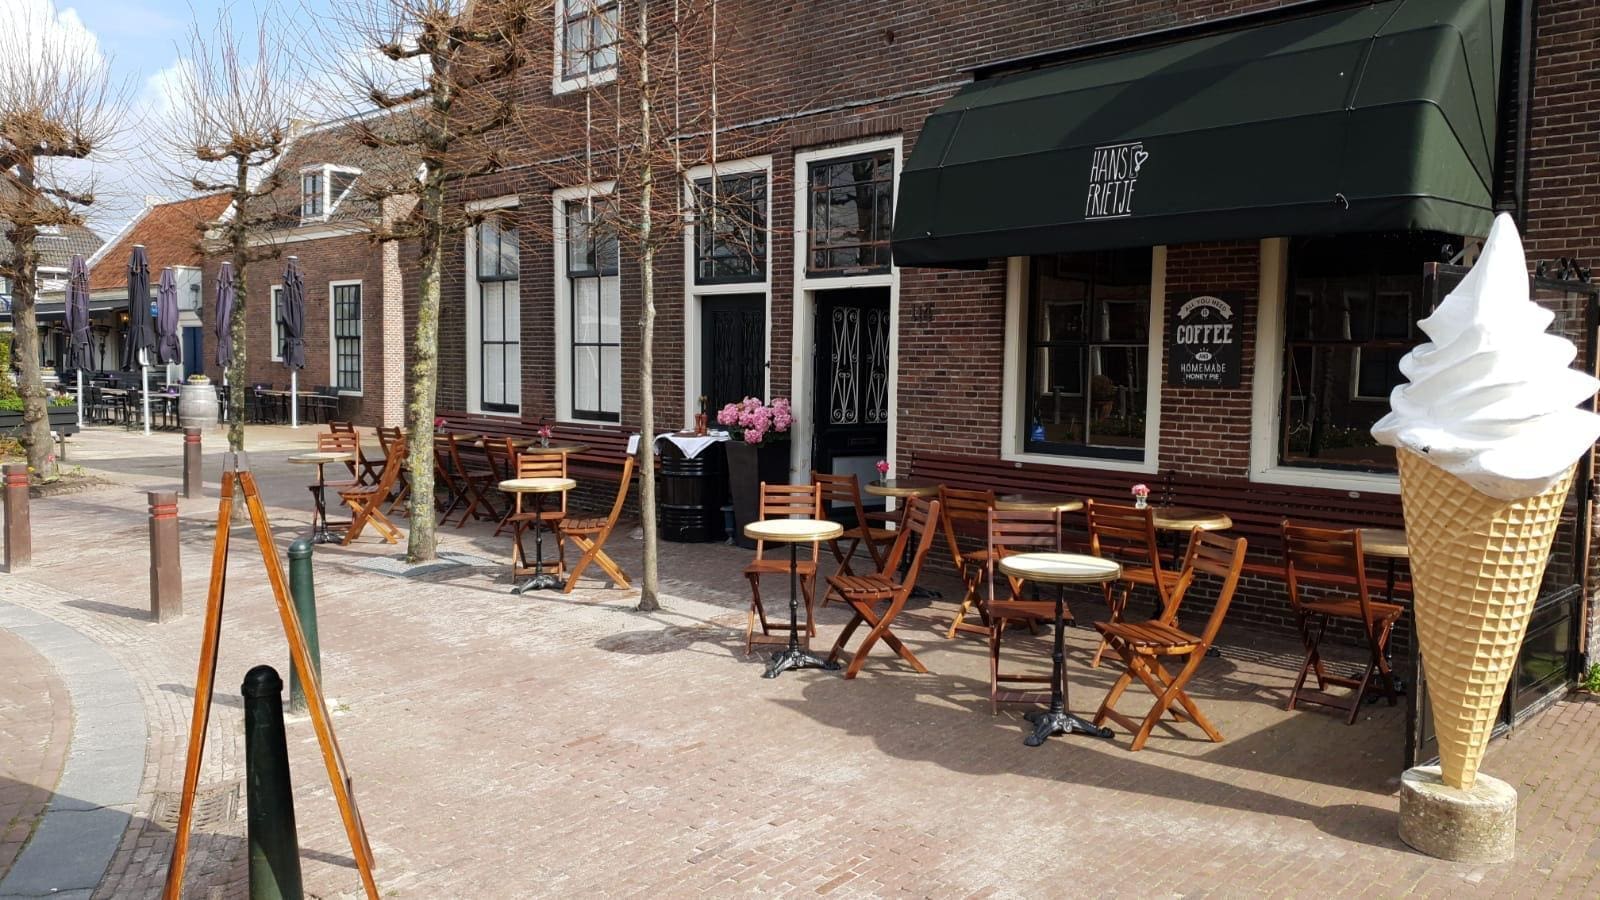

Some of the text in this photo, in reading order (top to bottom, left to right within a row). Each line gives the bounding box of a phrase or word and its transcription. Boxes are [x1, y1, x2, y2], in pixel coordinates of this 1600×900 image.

[1090, 147, 1128, 182] HANS
[1085, 179, 1137, 216] FRIETJE
[1211, 300, 1227, 311] NEED
[1176, 324, 1233, 344] COFFEE
[1180, 363, 1226, 373] HOMEMADE
